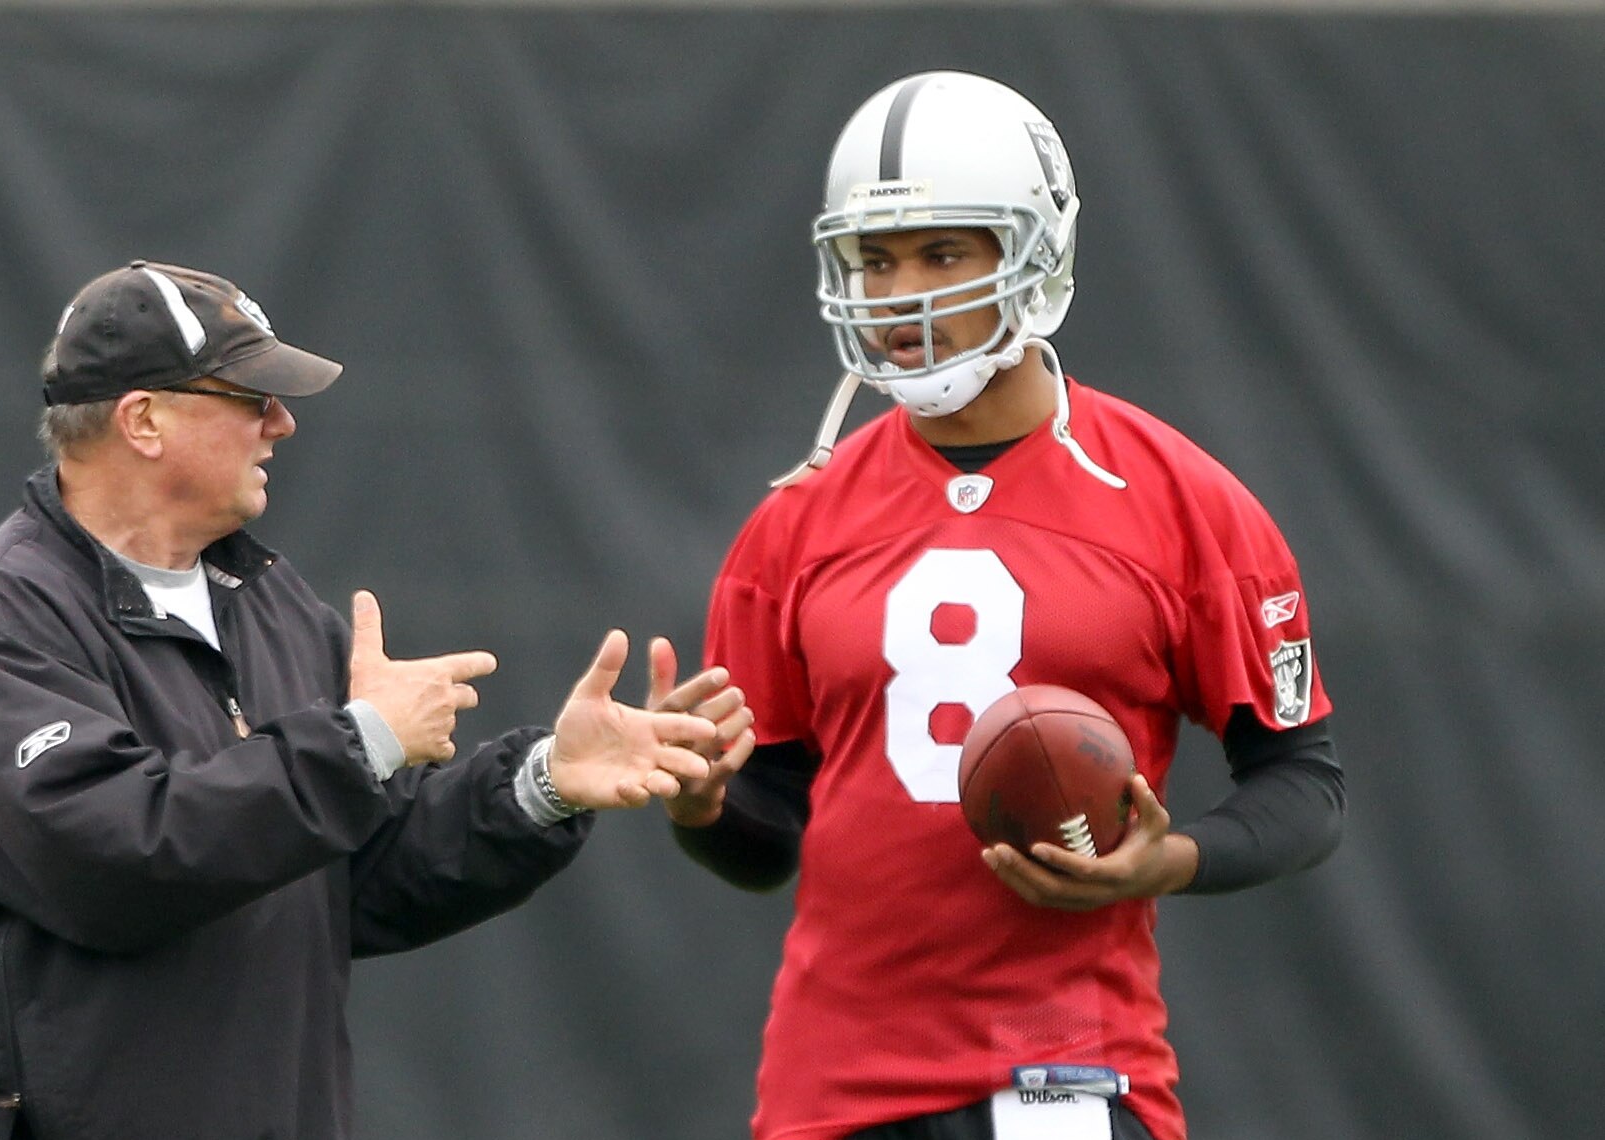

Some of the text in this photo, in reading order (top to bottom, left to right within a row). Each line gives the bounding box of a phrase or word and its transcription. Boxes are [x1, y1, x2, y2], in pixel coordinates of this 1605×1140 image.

[869, 187, 911, 199] RAIDERS
[883, 549, 1025, 803] 8
[1019, 1088, 1079, 1105] Wilson
